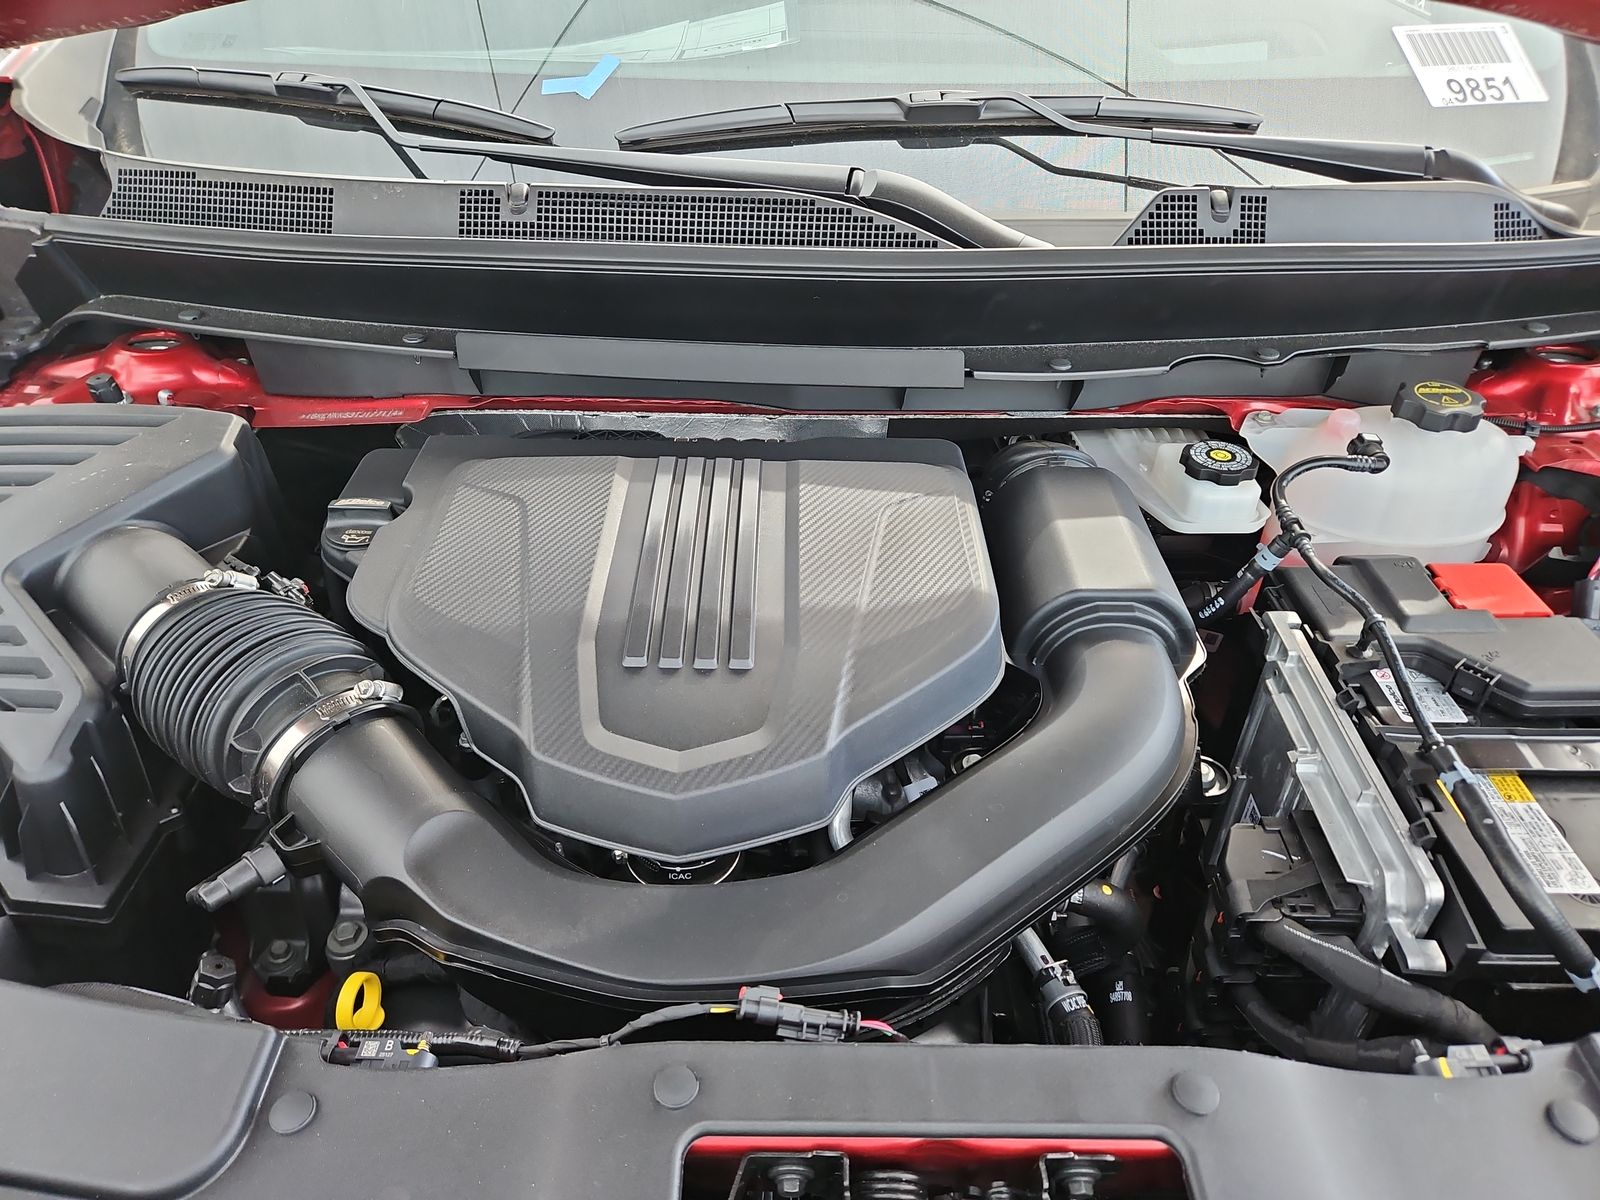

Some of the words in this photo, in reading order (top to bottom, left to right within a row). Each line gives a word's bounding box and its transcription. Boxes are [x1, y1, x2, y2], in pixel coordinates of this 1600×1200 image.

[1446, 76, 1520, 103] 9851
[668, 872, 692, 880] ICAC
[384, 1040, 394, 1051] B
